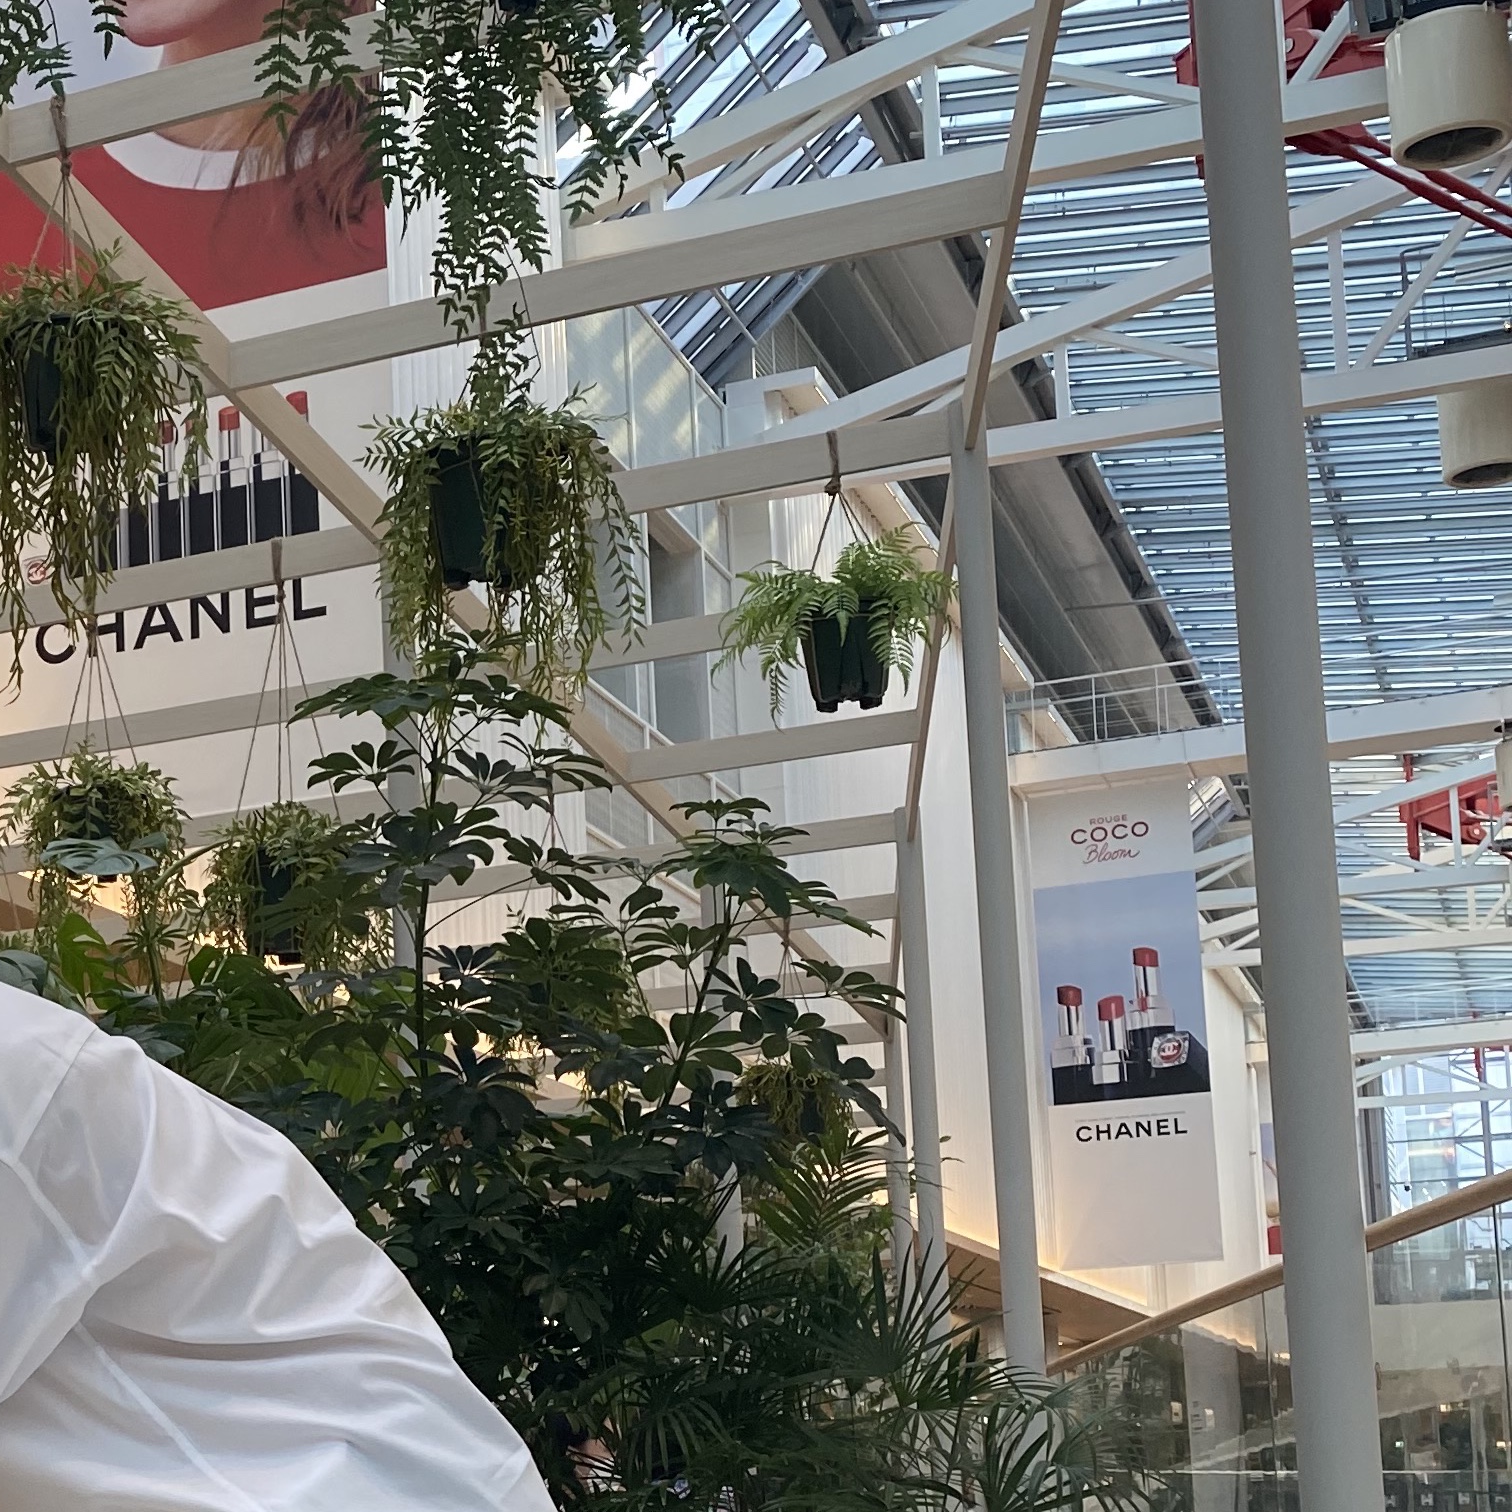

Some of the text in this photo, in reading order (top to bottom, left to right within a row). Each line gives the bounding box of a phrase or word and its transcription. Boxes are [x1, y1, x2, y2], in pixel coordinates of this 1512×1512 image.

[1089, 814, 1128, 825] ROUGE
[1070, 821, 1149, 844] COCO
[1082, 842, 1141, 865] Bloom
[1076, 1118, 1188, 1142] CHANEL
